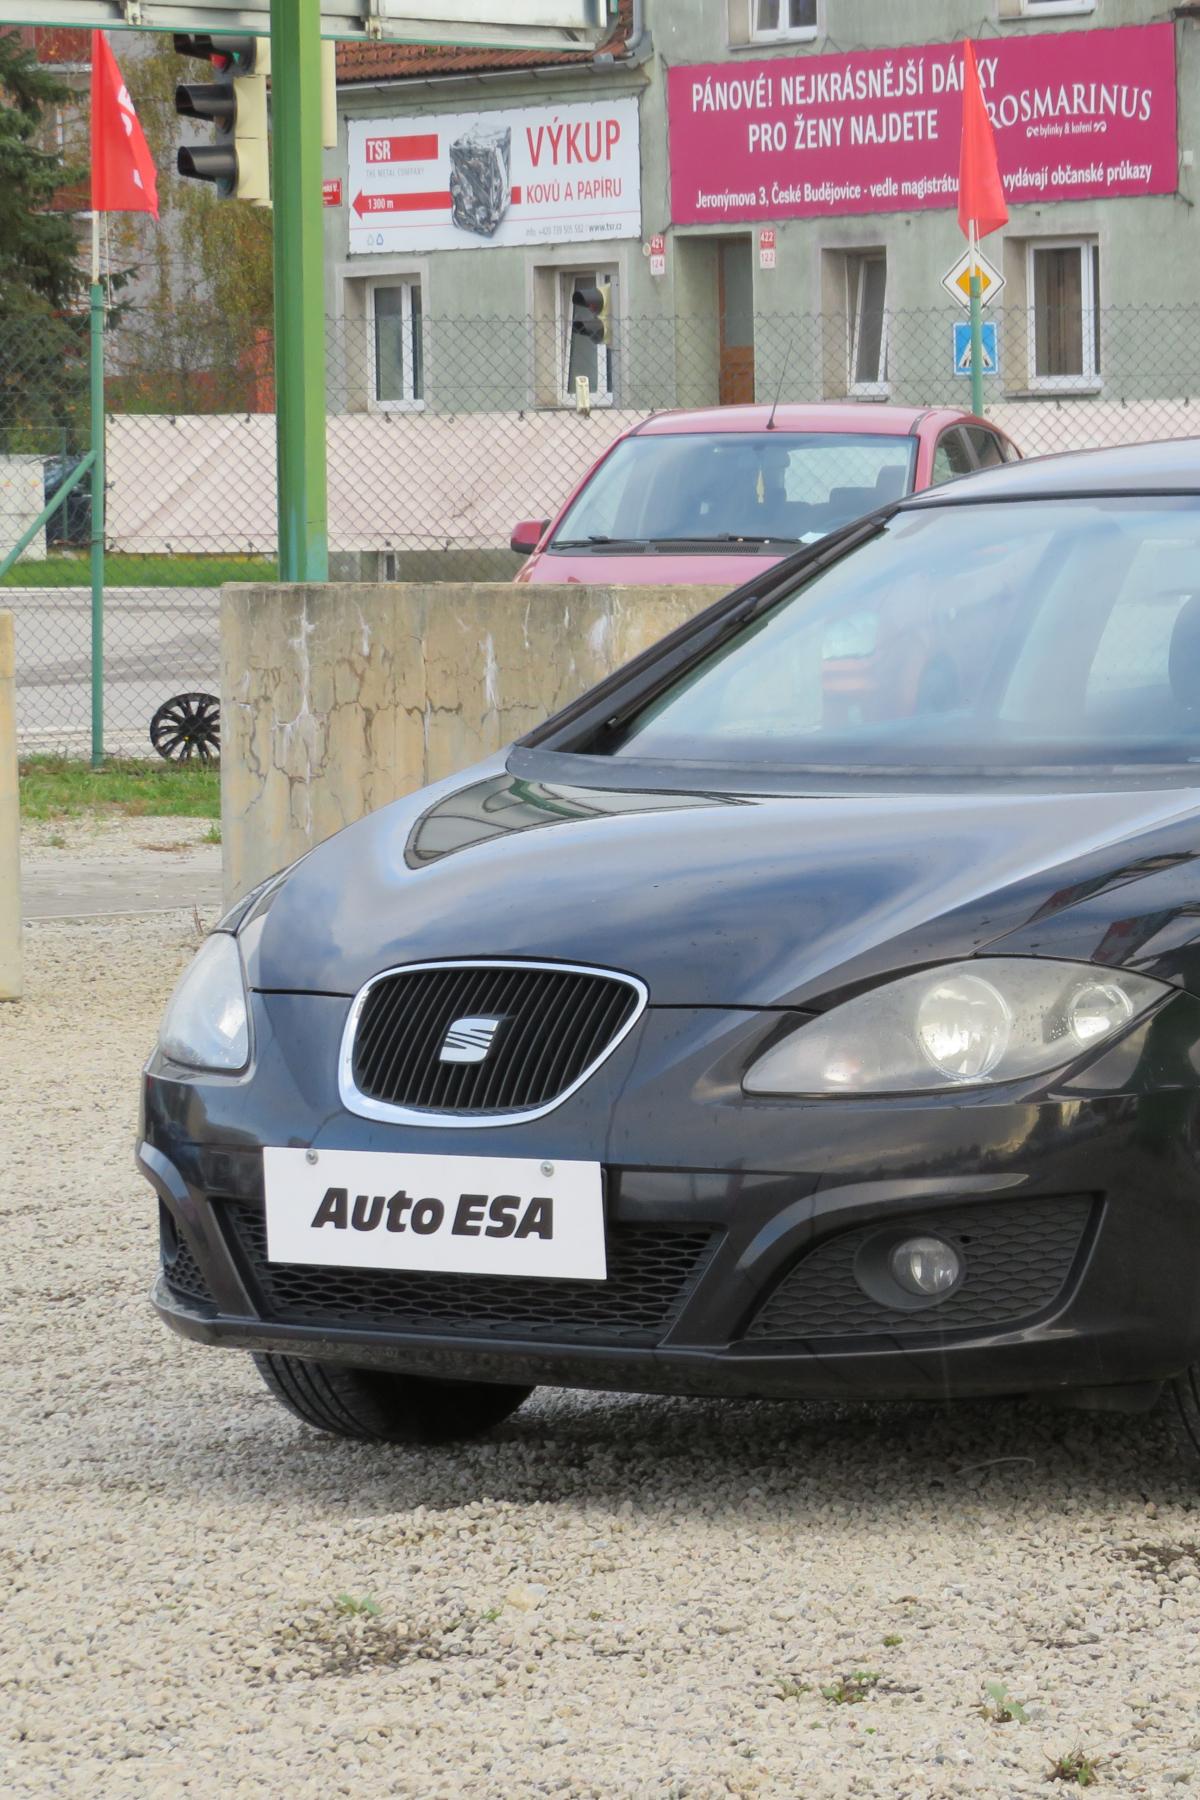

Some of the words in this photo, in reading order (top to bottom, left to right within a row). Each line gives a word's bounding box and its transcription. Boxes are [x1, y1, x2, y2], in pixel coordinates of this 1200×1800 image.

[692, 72, 773, 112] PÁNOVÉ!
[781, 57, 925, 106] NEJKRÁSNĚJŠÍ
[986, 83, 1152, 129] ROSMARINUS
[367, 140, 391, 161] TSR
[526, 116, 621, 167] VÝKUP
[748, 121, 787, 152] PRO
[793, 112, 845, 150] ŽENY
[850, 108, 939, 145] NAJDETE
[526, 178, 560, 204] KOVŮ
[564, 182, 574, 201] A
[577, 176, 622, 201] PAPÍRU
[695, 188, 757, 211] Jeronýmova
[759, 186, 769, 207] 3,
[771, 181, 802, 204] České
[804, 181, 861, 205] Budějovice
[870, 177, 898, 198] vedle
[1003, 166, 1048, 192] vydávají
[1051, 163, 1104, 184] občanské
[1106, 160, 1152, 186] průkazy
[760, 231, 774, 242] 422
[311, 1187, 445, 1235] Auto
[451, 1193, 554, 1240] ESA
